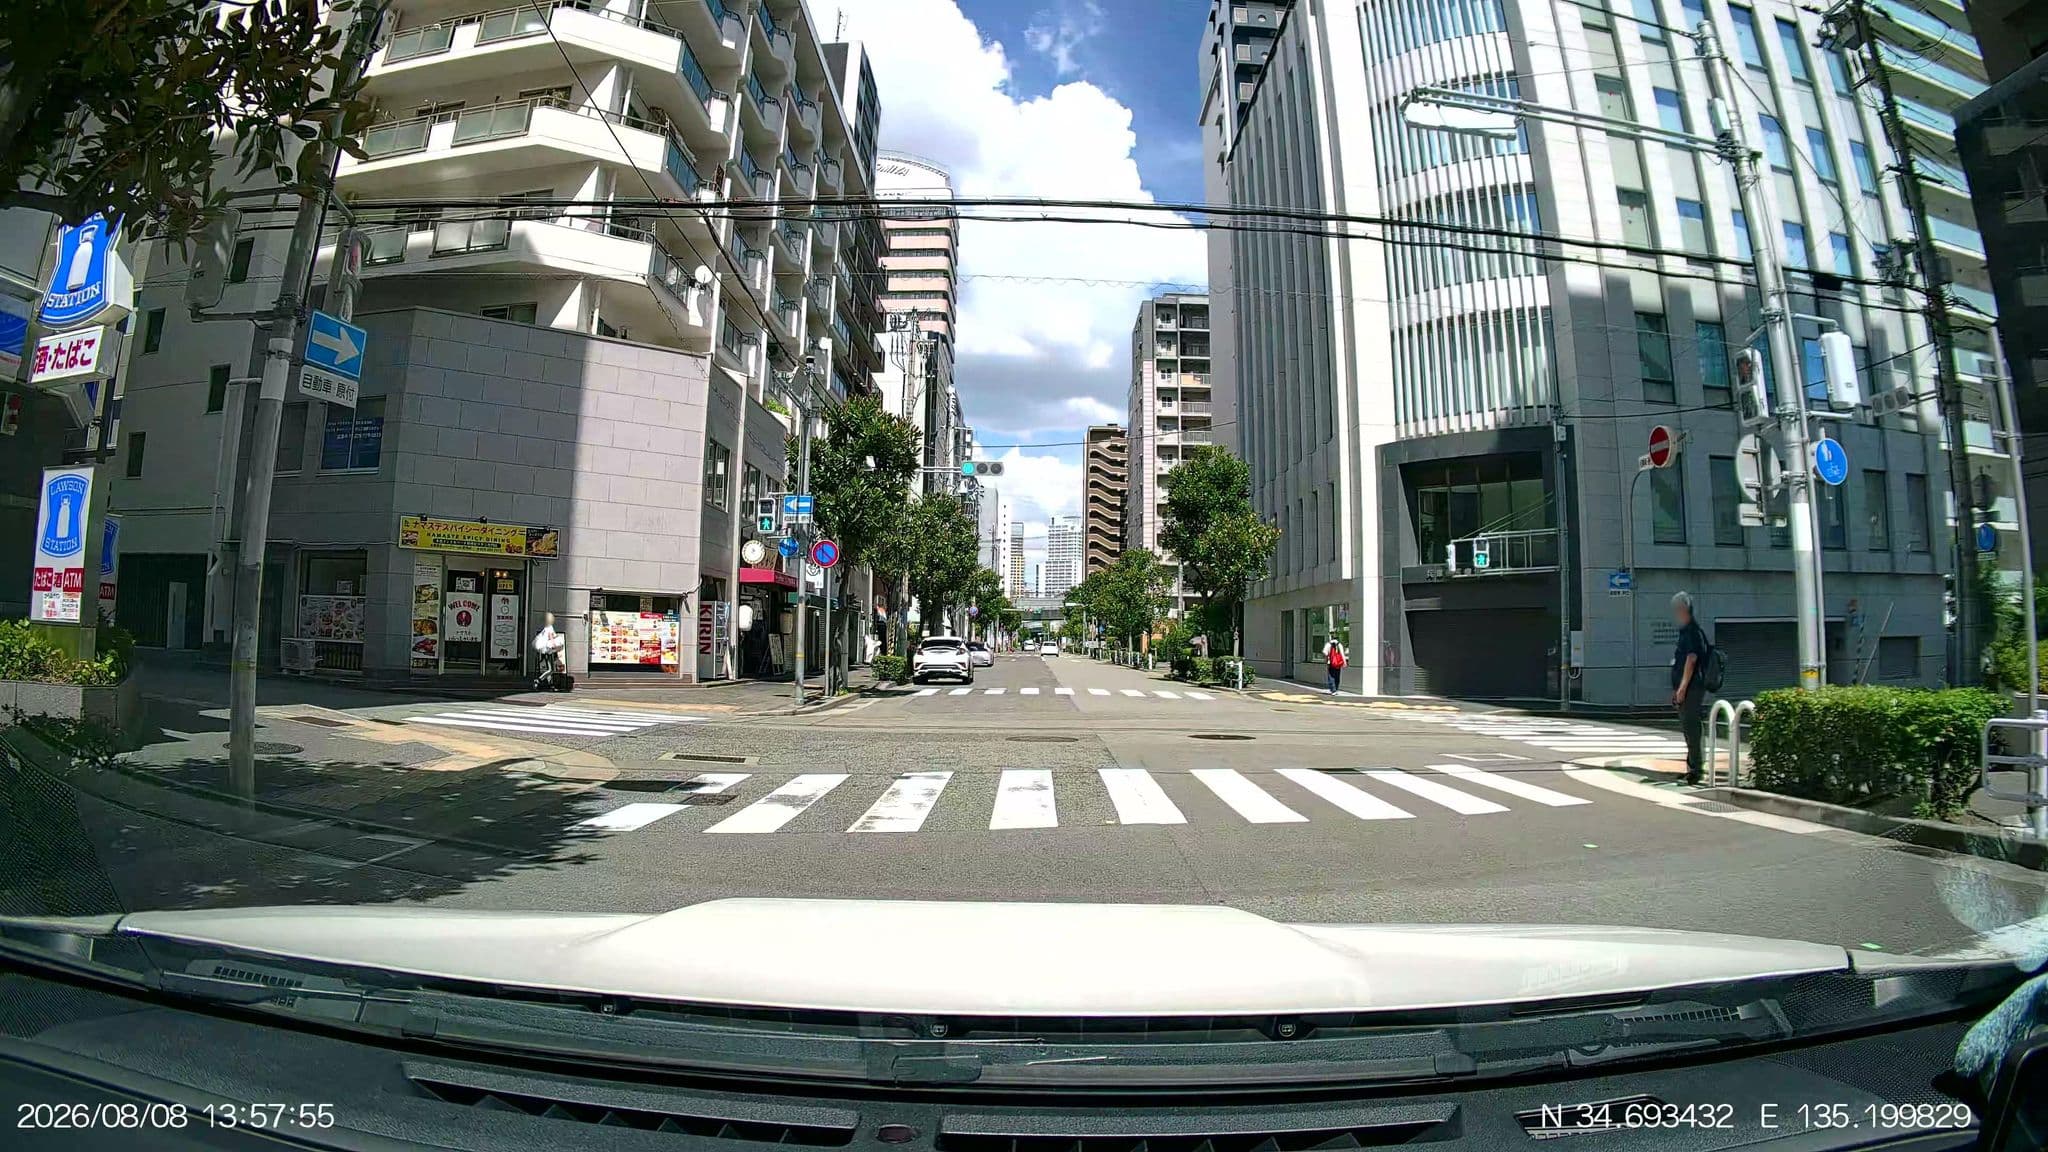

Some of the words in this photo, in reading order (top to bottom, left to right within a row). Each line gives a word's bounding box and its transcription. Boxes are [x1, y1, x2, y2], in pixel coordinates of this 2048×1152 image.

[46, 281, 102, 309] STATION
[302, 373, 333, 394] 自動車
[336, 383, 355, 401] 原付
[50, 480, 85, 496] LAWSON
[44, 536, 78, 552] STATION
[63, 572, 83, 588] ATM
[100, 586, 115, 597] ATM
[447, 599, 482, 612] WELCOME
[699, 604, 712, 655] KIRIN
